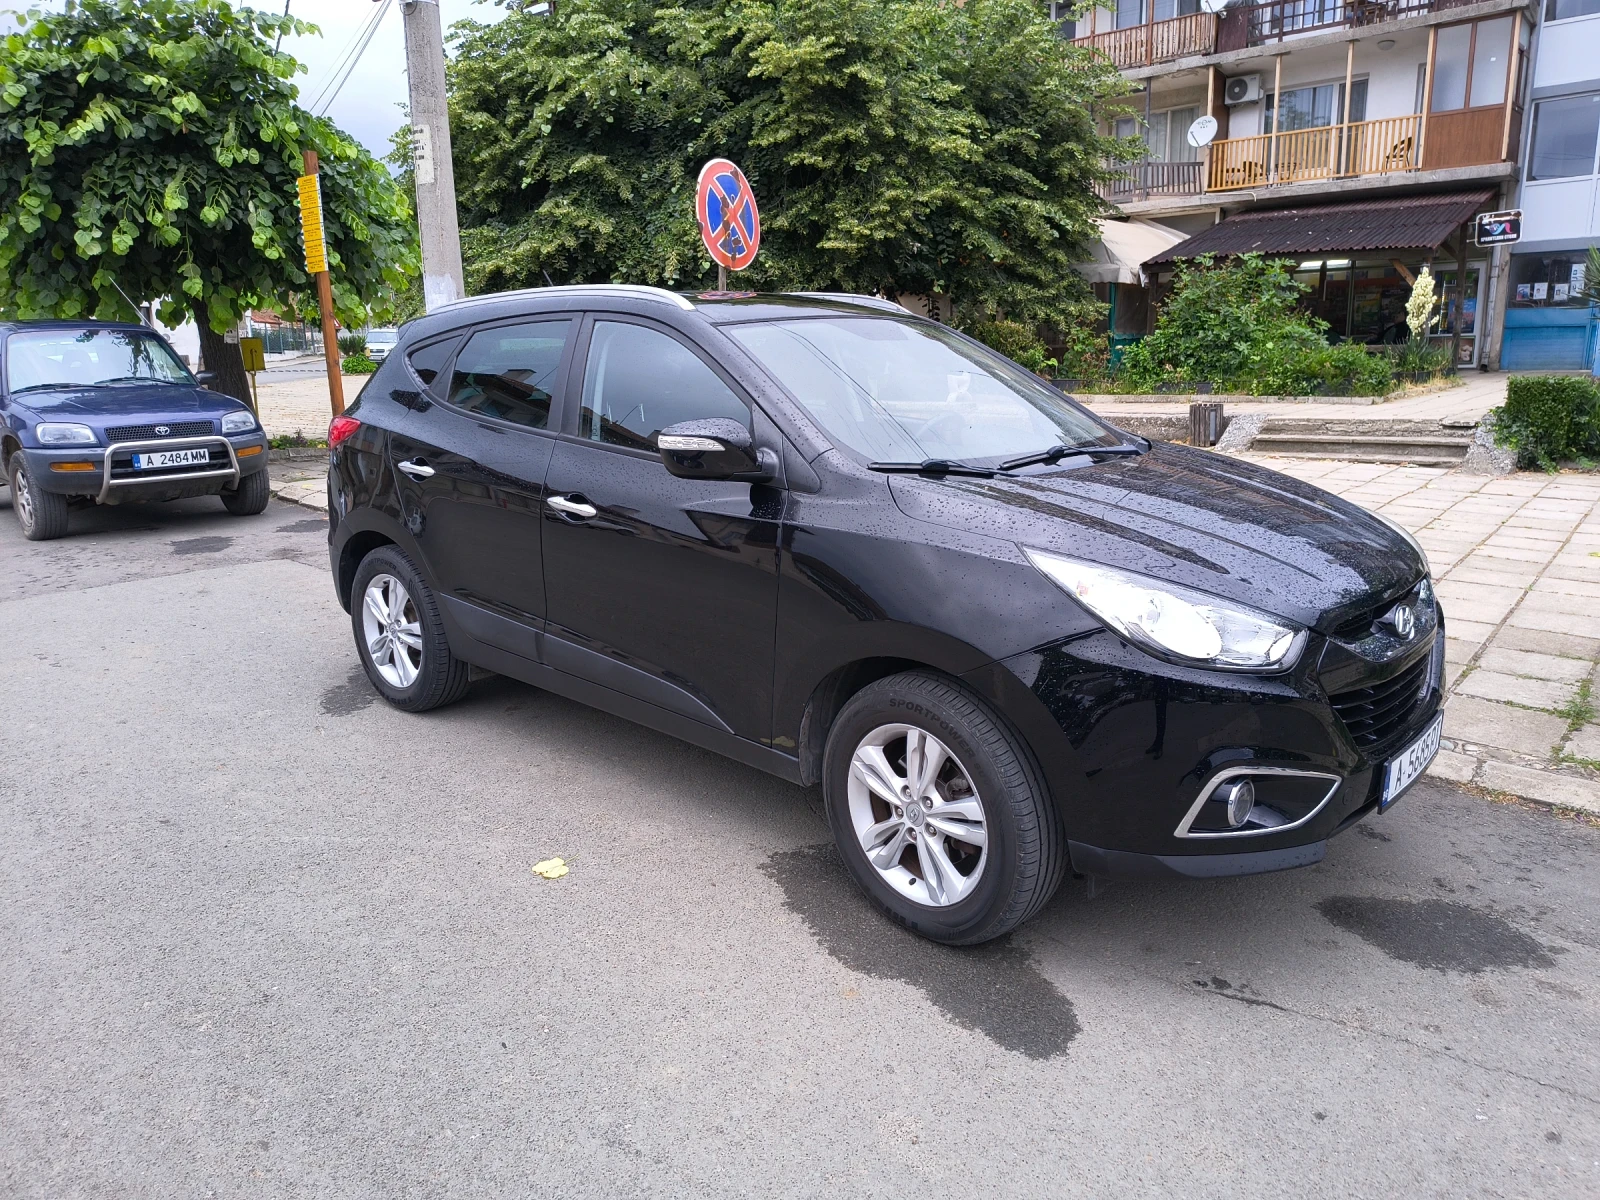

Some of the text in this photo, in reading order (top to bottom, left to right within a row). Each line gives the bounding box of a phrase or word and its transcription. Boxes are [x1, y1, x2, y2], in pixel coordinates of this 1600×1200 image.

[146, 455, 154, 466] A
[160, 452, 189, 465] 2484
[191, 450, 207, 462] MM
[889, 698, 976, 759] SPORTPOWER
